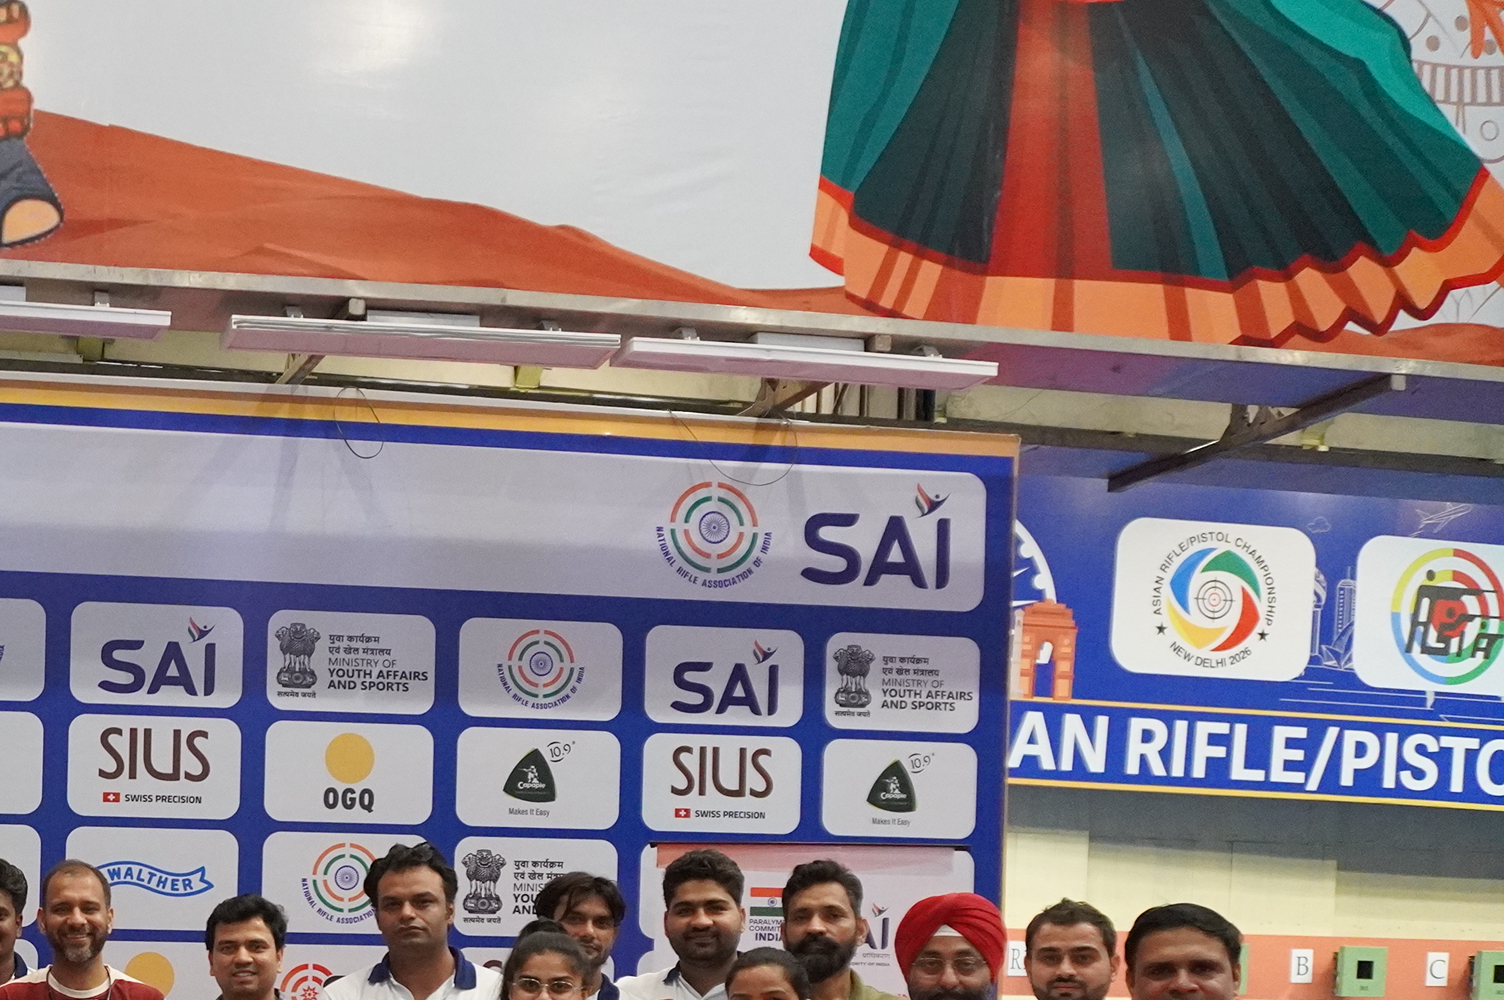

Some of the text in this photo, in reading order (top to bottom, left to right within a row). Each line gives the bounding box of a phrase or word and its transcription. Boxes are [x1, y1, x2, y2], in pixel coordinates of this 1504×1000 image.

[656, 526, 772, 588] NATIONAL RIFLE ASSOCIATION OF INDIA
[800, 512, 951, 590] SAI
[1152, 532, 1276, 626] ASIAN RIFLE/PISTOL CHAMPIONSHIP
[329, 634, 344, 645] युवा
[328, 657, 397, 668] MINISTRY OF
[1170, 641, 1252, 668] NEW DELHI 2026
[98, 639, 216, 696] SAI
[328, 668, 428, 682] YOUTH AFFAIRS
[328, 680, 409, 692] AND SPORTS
[497, 663, 584, 710] NATIONAL RIFLE ASSOCIATION OF INDIA
[670, 661, 778, 716] SAI
[882, 677, 944, 688] MINISTRY OF
[882, 688, 973, 701] YOUTH AFFAIRS
[881, 699, 956, 711] AND SPORTS
[98, 727, 211, 782] SIUS
[670, 745, 773, 798] SIUS
[125, 793, 202, 804] SWISS PRECISION
[323, 787, 374, 813] OGQ
[536, 808, 550, 817] Easy
[695, 810, 766, 820] SWISS PRECISION
[897, 818, 910, 826] Easy
[514, 859, 564, 870] युवा कार्यक्रम
[107, 867, 193, 891] WALTHER
[514, 872, 525, 880] एवं
[528, 870, 544, 880] खेल
[302, 878, 317, 908] NATIONAL
[317, 908, 334, 921] RIFLE
[1297, 956, 1309, 976] B
[1430, 960, 1446, 979] C
